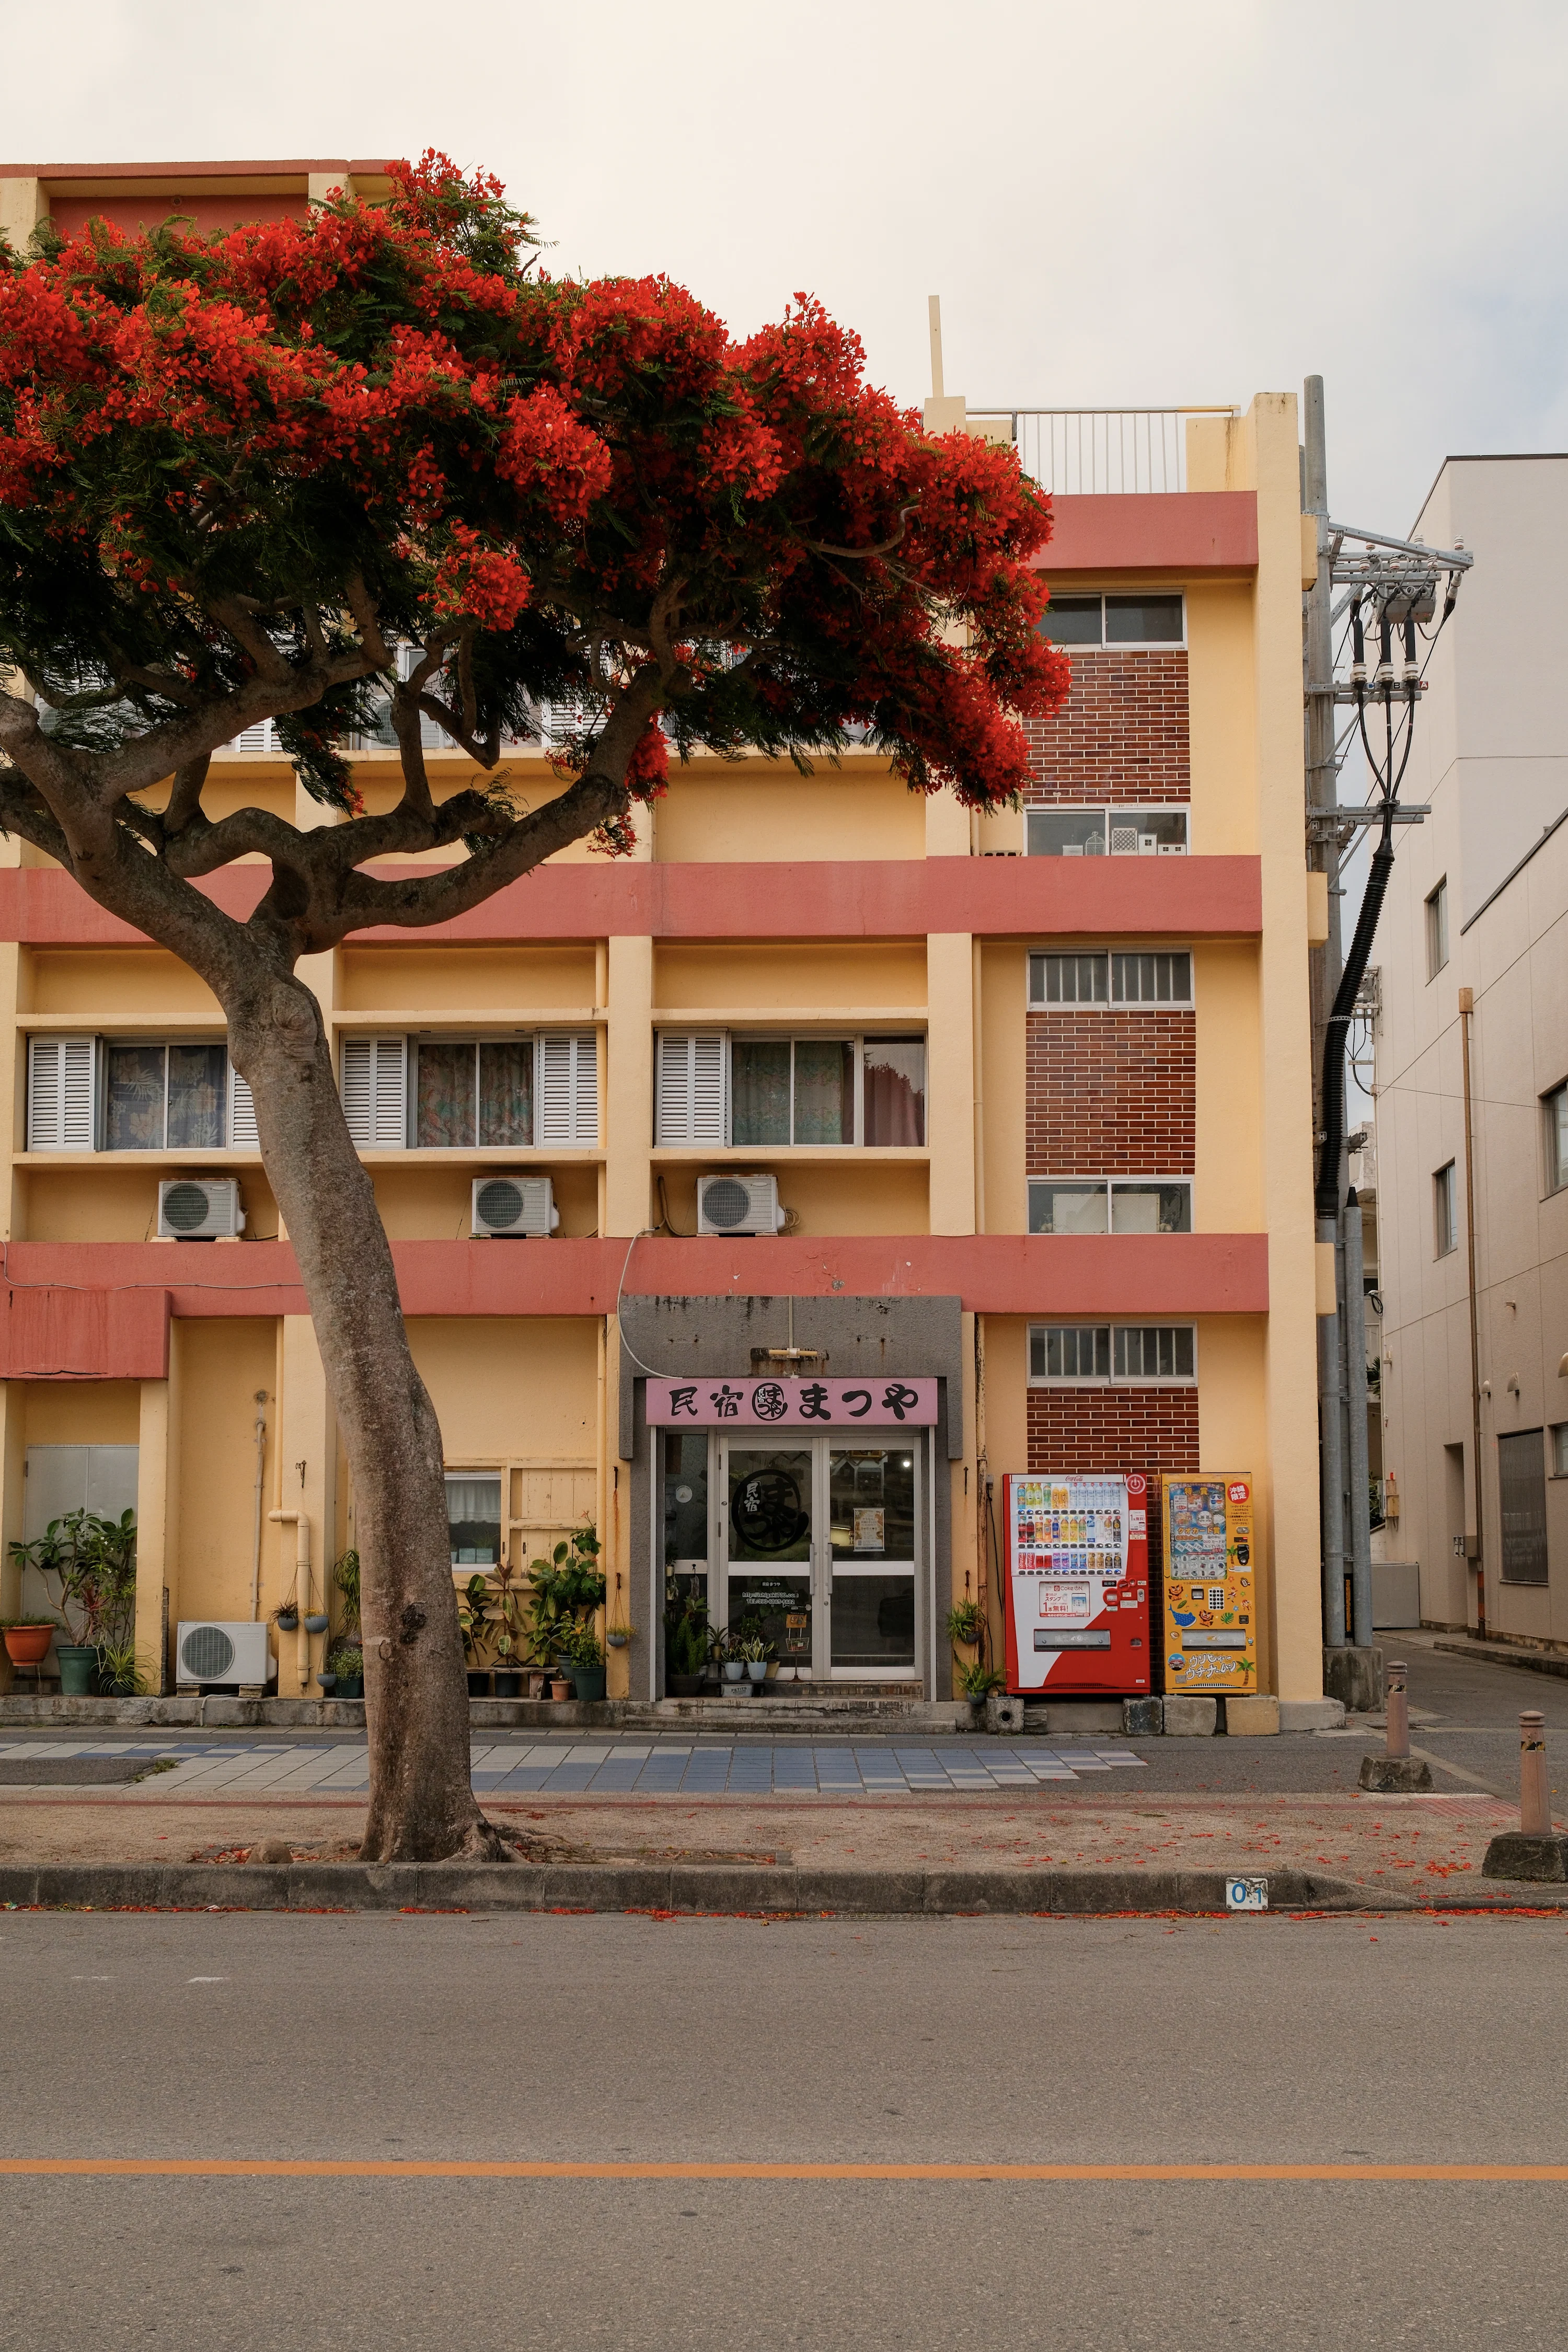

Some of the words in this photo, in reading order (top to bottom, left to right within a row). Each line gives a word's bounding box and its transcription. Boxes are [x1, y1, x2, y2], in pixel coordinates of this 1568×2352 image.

[669, 1385, 744, 1417] 民宿
[799, 1383, 919, 1421] まつや
[744, 1482, 760, 1512] 民宿
[1229, 1485, 1245, 1494] 沖縄
[1230, 1492, 1247, 1501] 限定
[1178, 1526, 1220, 1535] クオカード賞
[1189, 1653, 1232, 1668] ウリヒャー
[1231, 1883, 1262, 1904] 0.1
